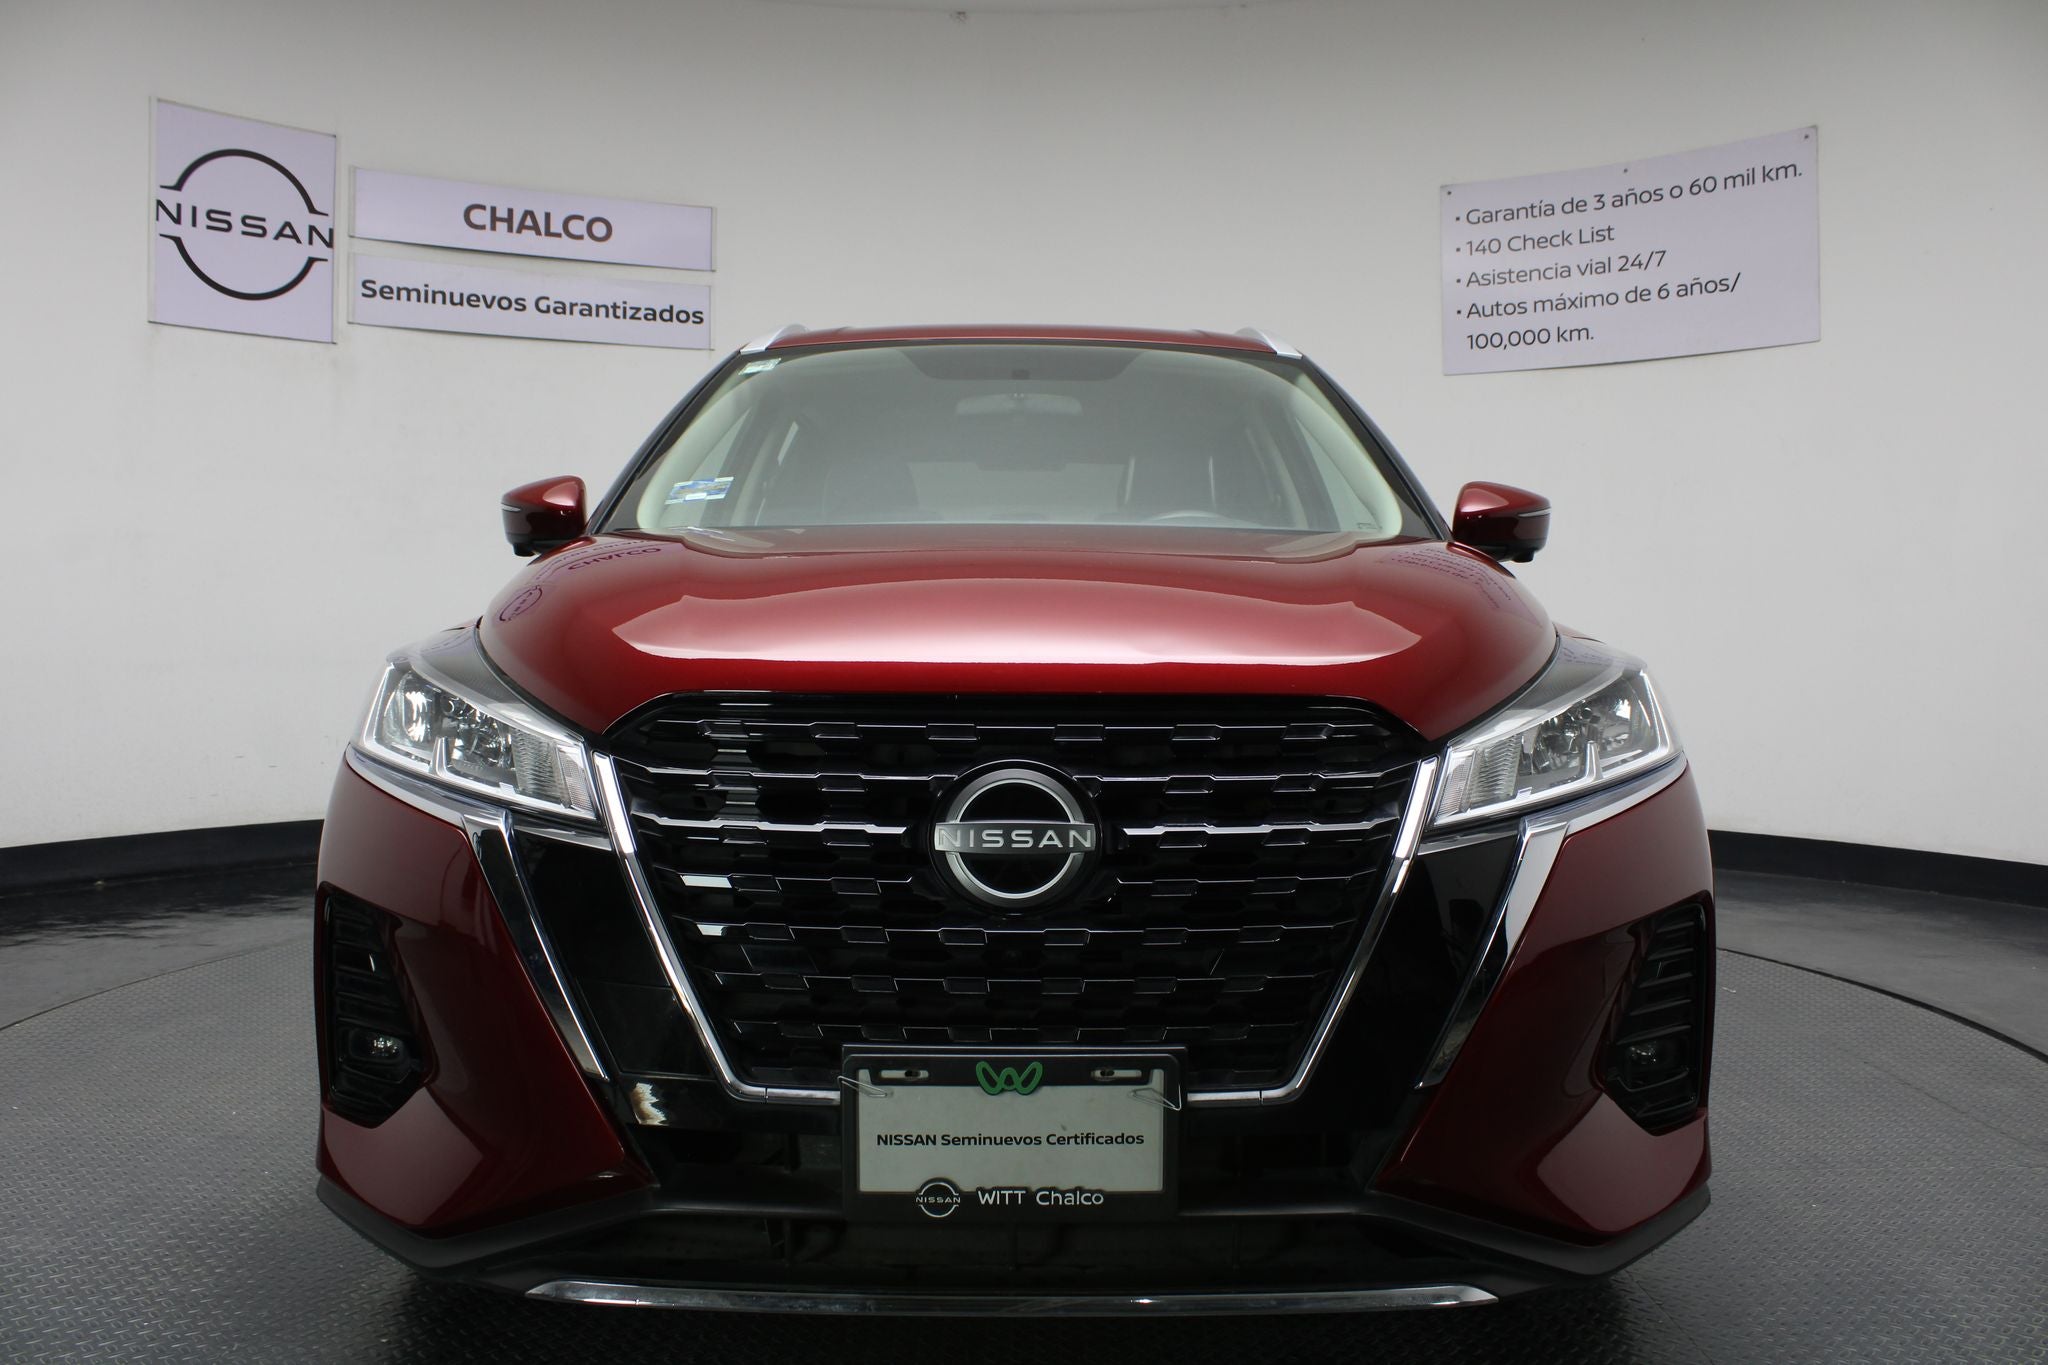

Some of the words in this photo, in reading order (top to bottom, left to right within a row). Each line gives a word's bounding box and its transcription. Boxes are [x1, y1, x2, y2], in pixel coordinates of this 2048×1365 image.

[1465, 199, 1556, 226] Garantía
[1561, 197, 1588, 216] de
[1593, 193, 1606, 211] 3
[1611, 187, 1664, 209] años
[1669, 184, 1684, 200] o
[1689, 175, 1718, 197] 60
[1723, 166, 1757, 191] mil
[1762, 161, 1803, 184] km.
[155, 199, 334, 249] NISSAN
[463, 203, 613, 243] CHALCO
[1466, 239, 1502, 256] 140
[1507, 229, 1574, 253] Check
[1579, 223, 1616, 244] List
[1466, 266, 1572, 288] Asistencia
[1577, 256, 1612, 276] vial
[1617, 249, 1667, 274] 24/7
[360, 279, 527, 313] Seminuevos
[533, 295, 705, 325] Garantizados
[1466, 300, 1528, 319] Autos
[1533, 290, 1620, 313] máximo
[1625, 284, 1652, 304] de
[1657, 282, 1670, 301] 6
[1675, 271, 1741, 298] años/
[1466, 327, 1552, 351] 100,000
[1556, 325, 1595, 344] km.
[938, 829, 1092, 849] NISSAN
[876, 1133, 938, 1147] NISSAN
[940, 1132, 1043, 1147] Seminuevos
[1045, 1131, 1146, 1147] Certificados
[915, 1195, 961, 1204] NISSAN
[976, 1190, 1027, 1206] WITT
[1035, 1190, 1105, 1206] Chalco
